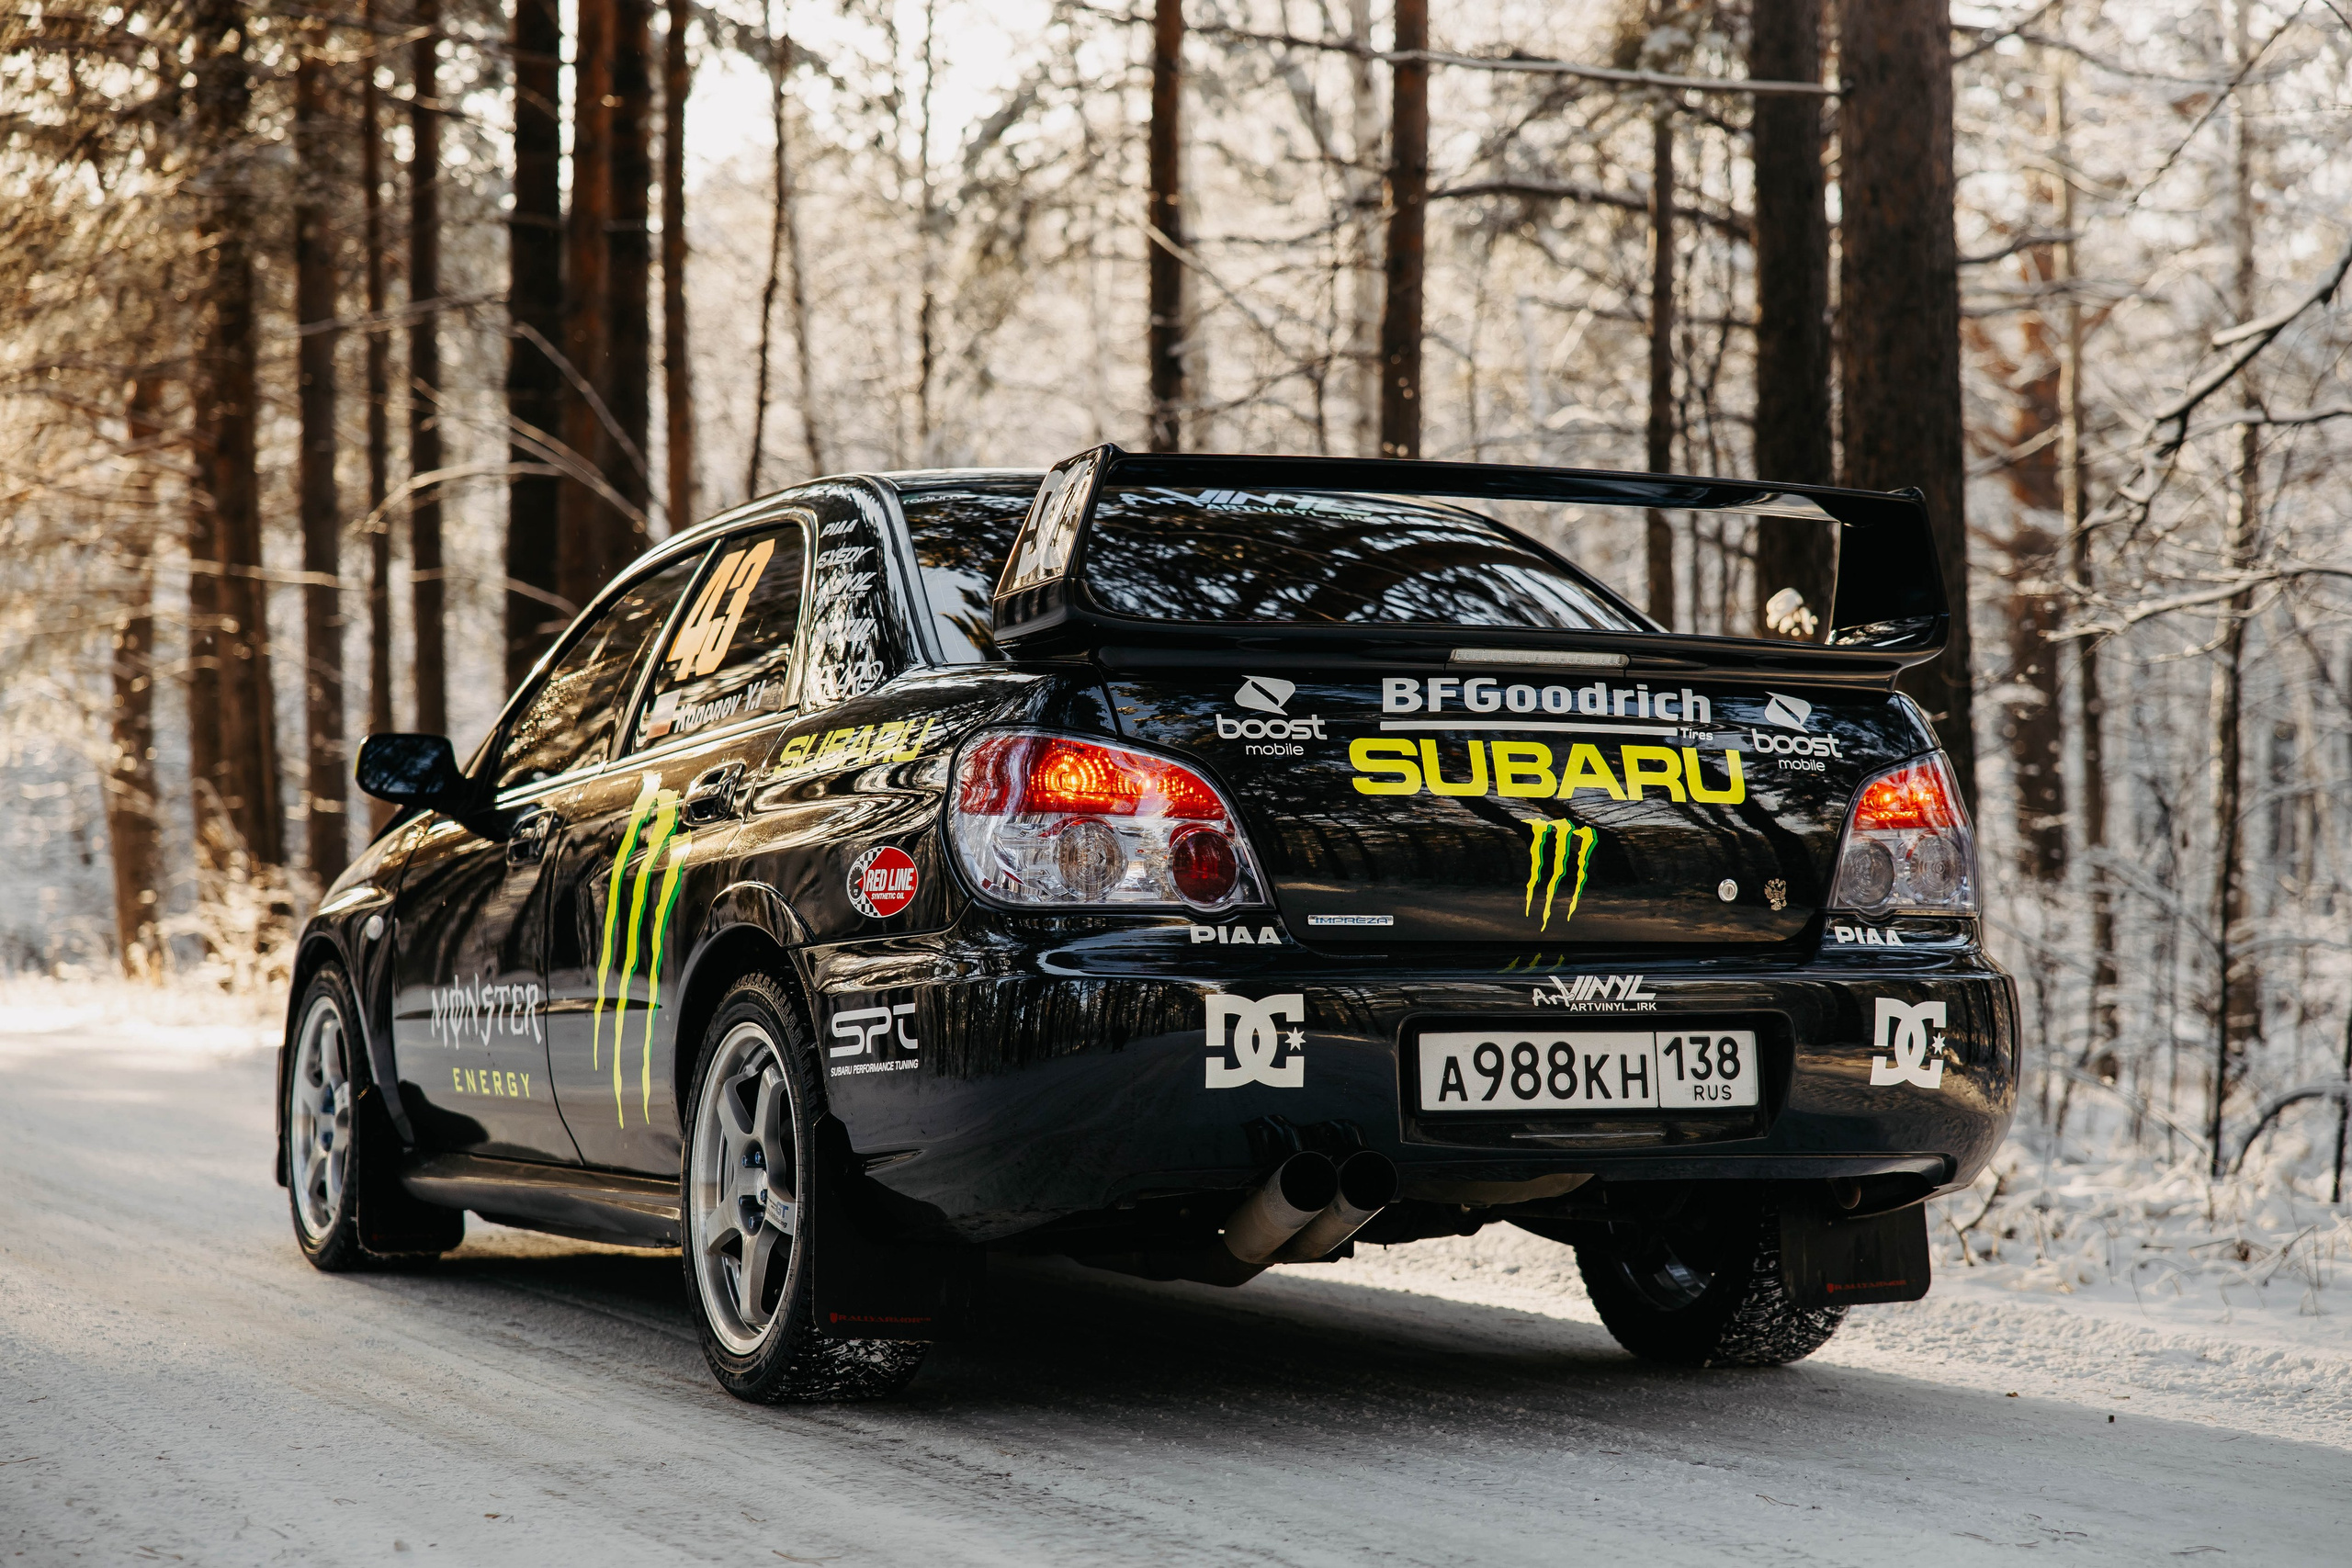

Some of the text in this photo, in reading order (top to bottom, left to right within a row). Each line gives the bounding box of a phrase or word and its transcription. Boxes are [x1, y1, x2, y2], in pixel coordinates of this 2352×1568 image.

[820, 519, 858, 538] PIAA
[817, 547, 875, 570] EXEDY
[666, 538, 775, 682] 43
[1383, 678, 1711, 724] BFGoodrich
[673, 694, 742, 733] Kononov
[1216, 714, 1328, 740] boost
[1680, 728, 1713, 741] Tires
[774, 717, 935, 777] SUBARU
[1246, 743, 1304, 756] mobile
[1752, 729, 1843, 759] boost
[1350, 738, 1746, 805] SUBARU
[1779, 758, 1826, 772] mobile
[865, 869, 888, 892] RED
[871, 892, 896, 900] SYNTHETIC
[1190, 926, 1282, 944] PIAA
[1834, 926, 1905, 947] PIAA
[1570, 1002, 1657, 1011] ARTVINYL_IRK
[830, 1003, 918, 1058] SPT
[1205, 994, 1306, 1089] DC
[1871, 998, 1947, 1089] DC
[831, 1059, 919, 1077] SUBARU PERFORMANCE TUNING
[1664, 1037, 1741, 1080] 138
[453, 1067, 530, 1098] ENERGY
[1694, 1085, 1732, 1100] RUS
